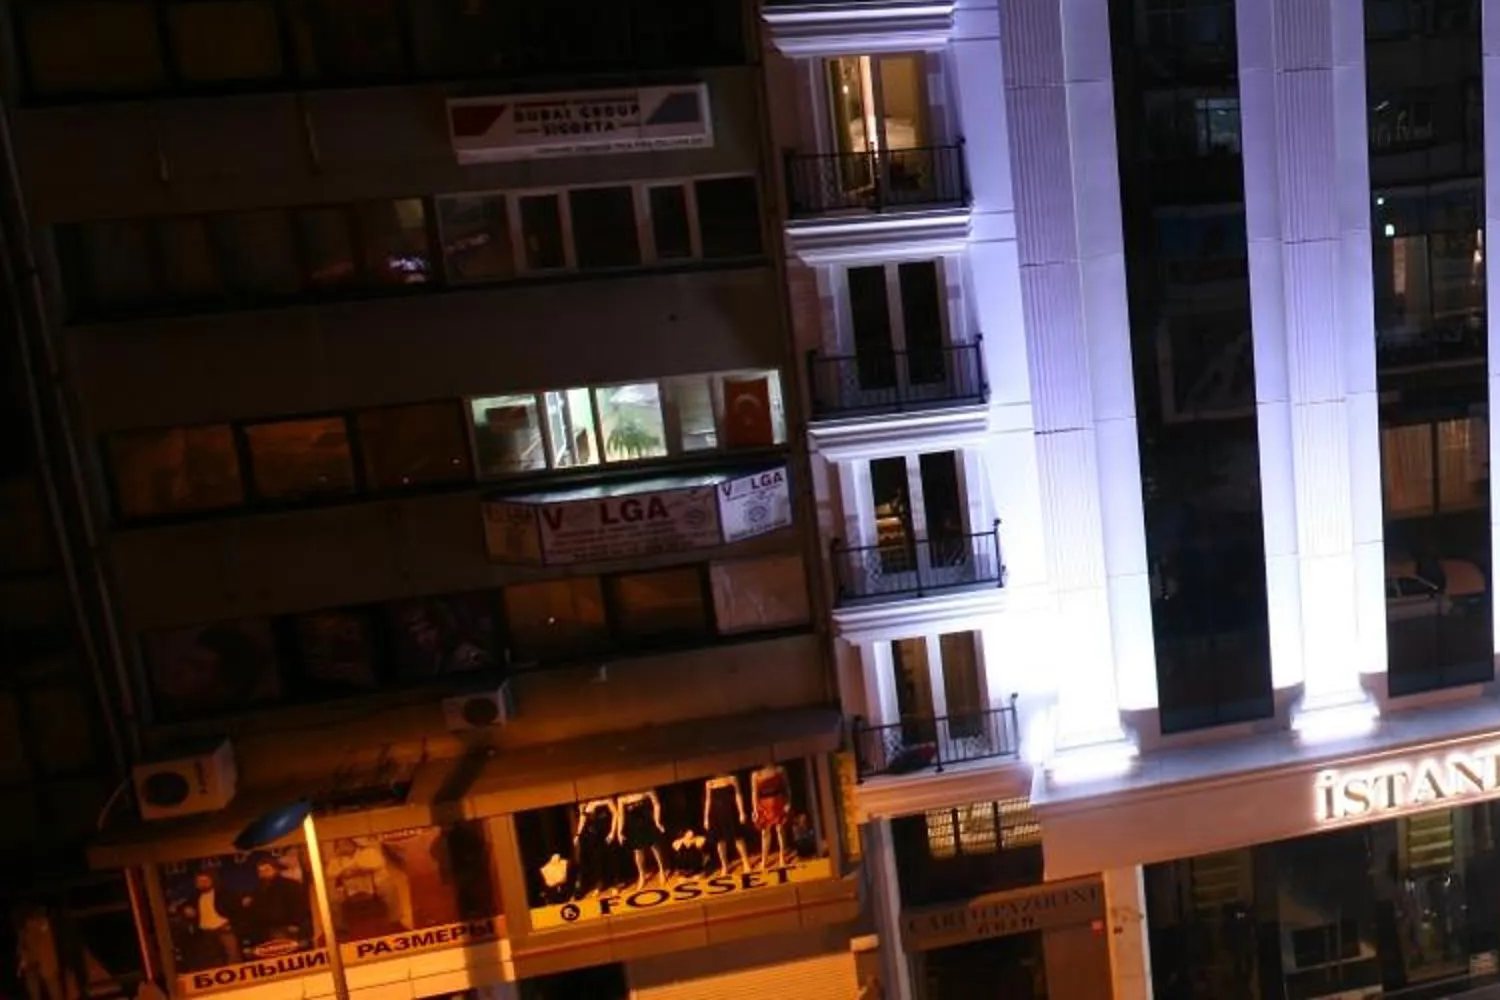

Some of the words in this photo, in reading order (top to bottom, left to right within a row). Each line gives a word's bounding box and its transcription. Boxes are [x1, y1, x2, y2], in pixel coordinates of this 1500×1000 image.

[599, 865, 797, 915] FOSSET
[193, 950, 332, 989] БОЛЬШИ
[356, 915, 494, 959] РАЗМЕРЫ
